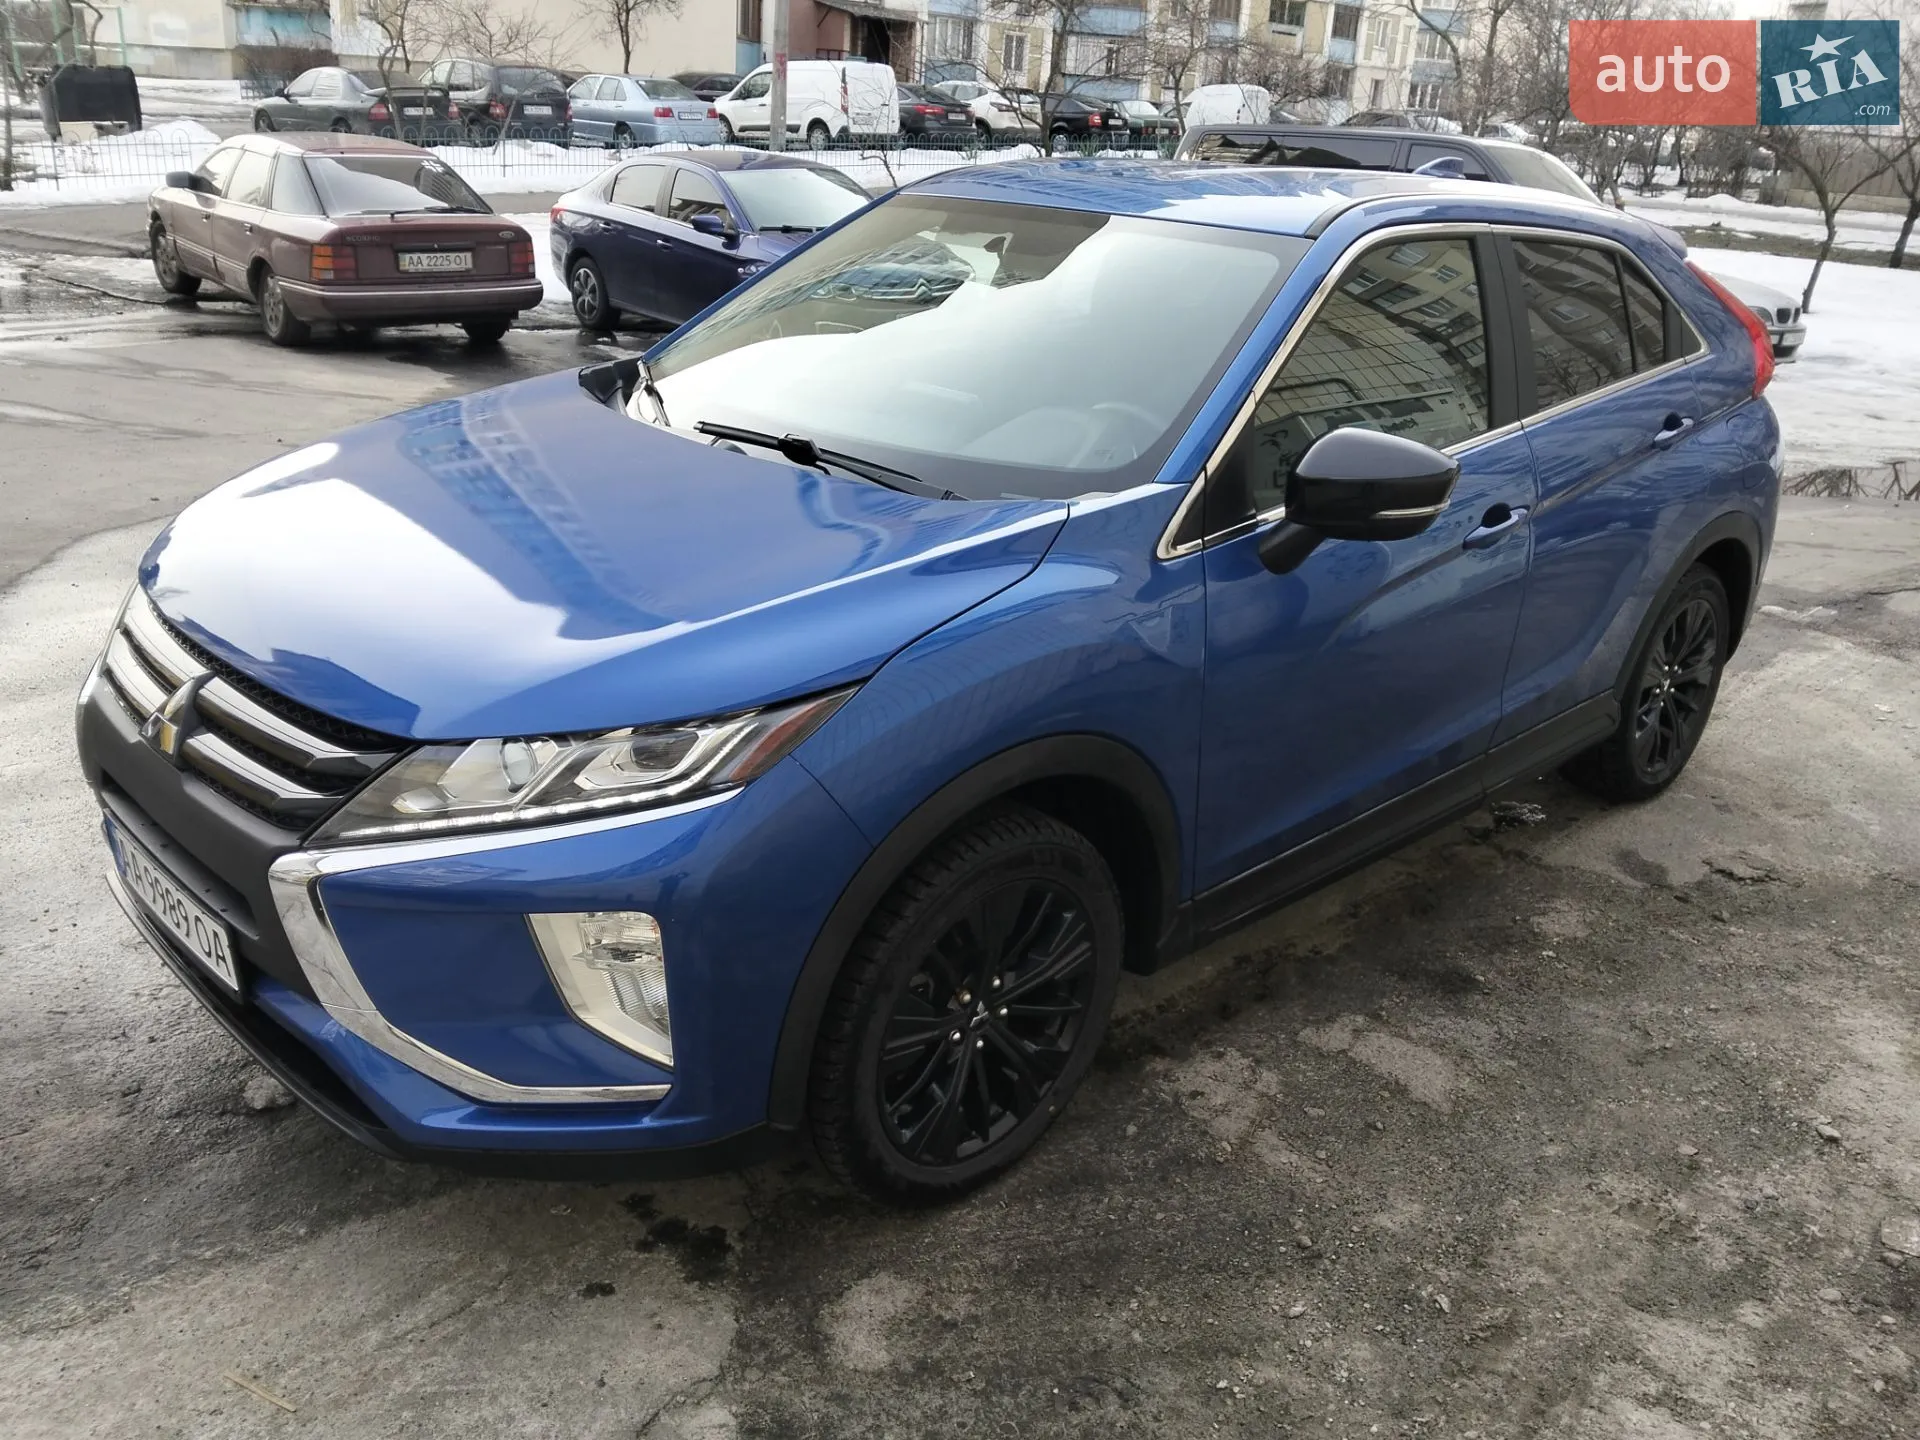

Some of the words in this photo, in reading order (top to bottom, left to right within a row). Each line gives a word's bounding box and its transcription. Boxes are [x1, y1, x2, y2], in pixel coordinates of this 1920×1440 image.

[408, 255, 424, 267] AA
[426, 255, 451, 267] 2225
[119, 838, 147, 897] AA
[143, 865, 190, 938] 9989
[195, 914, 232, 979] OA
